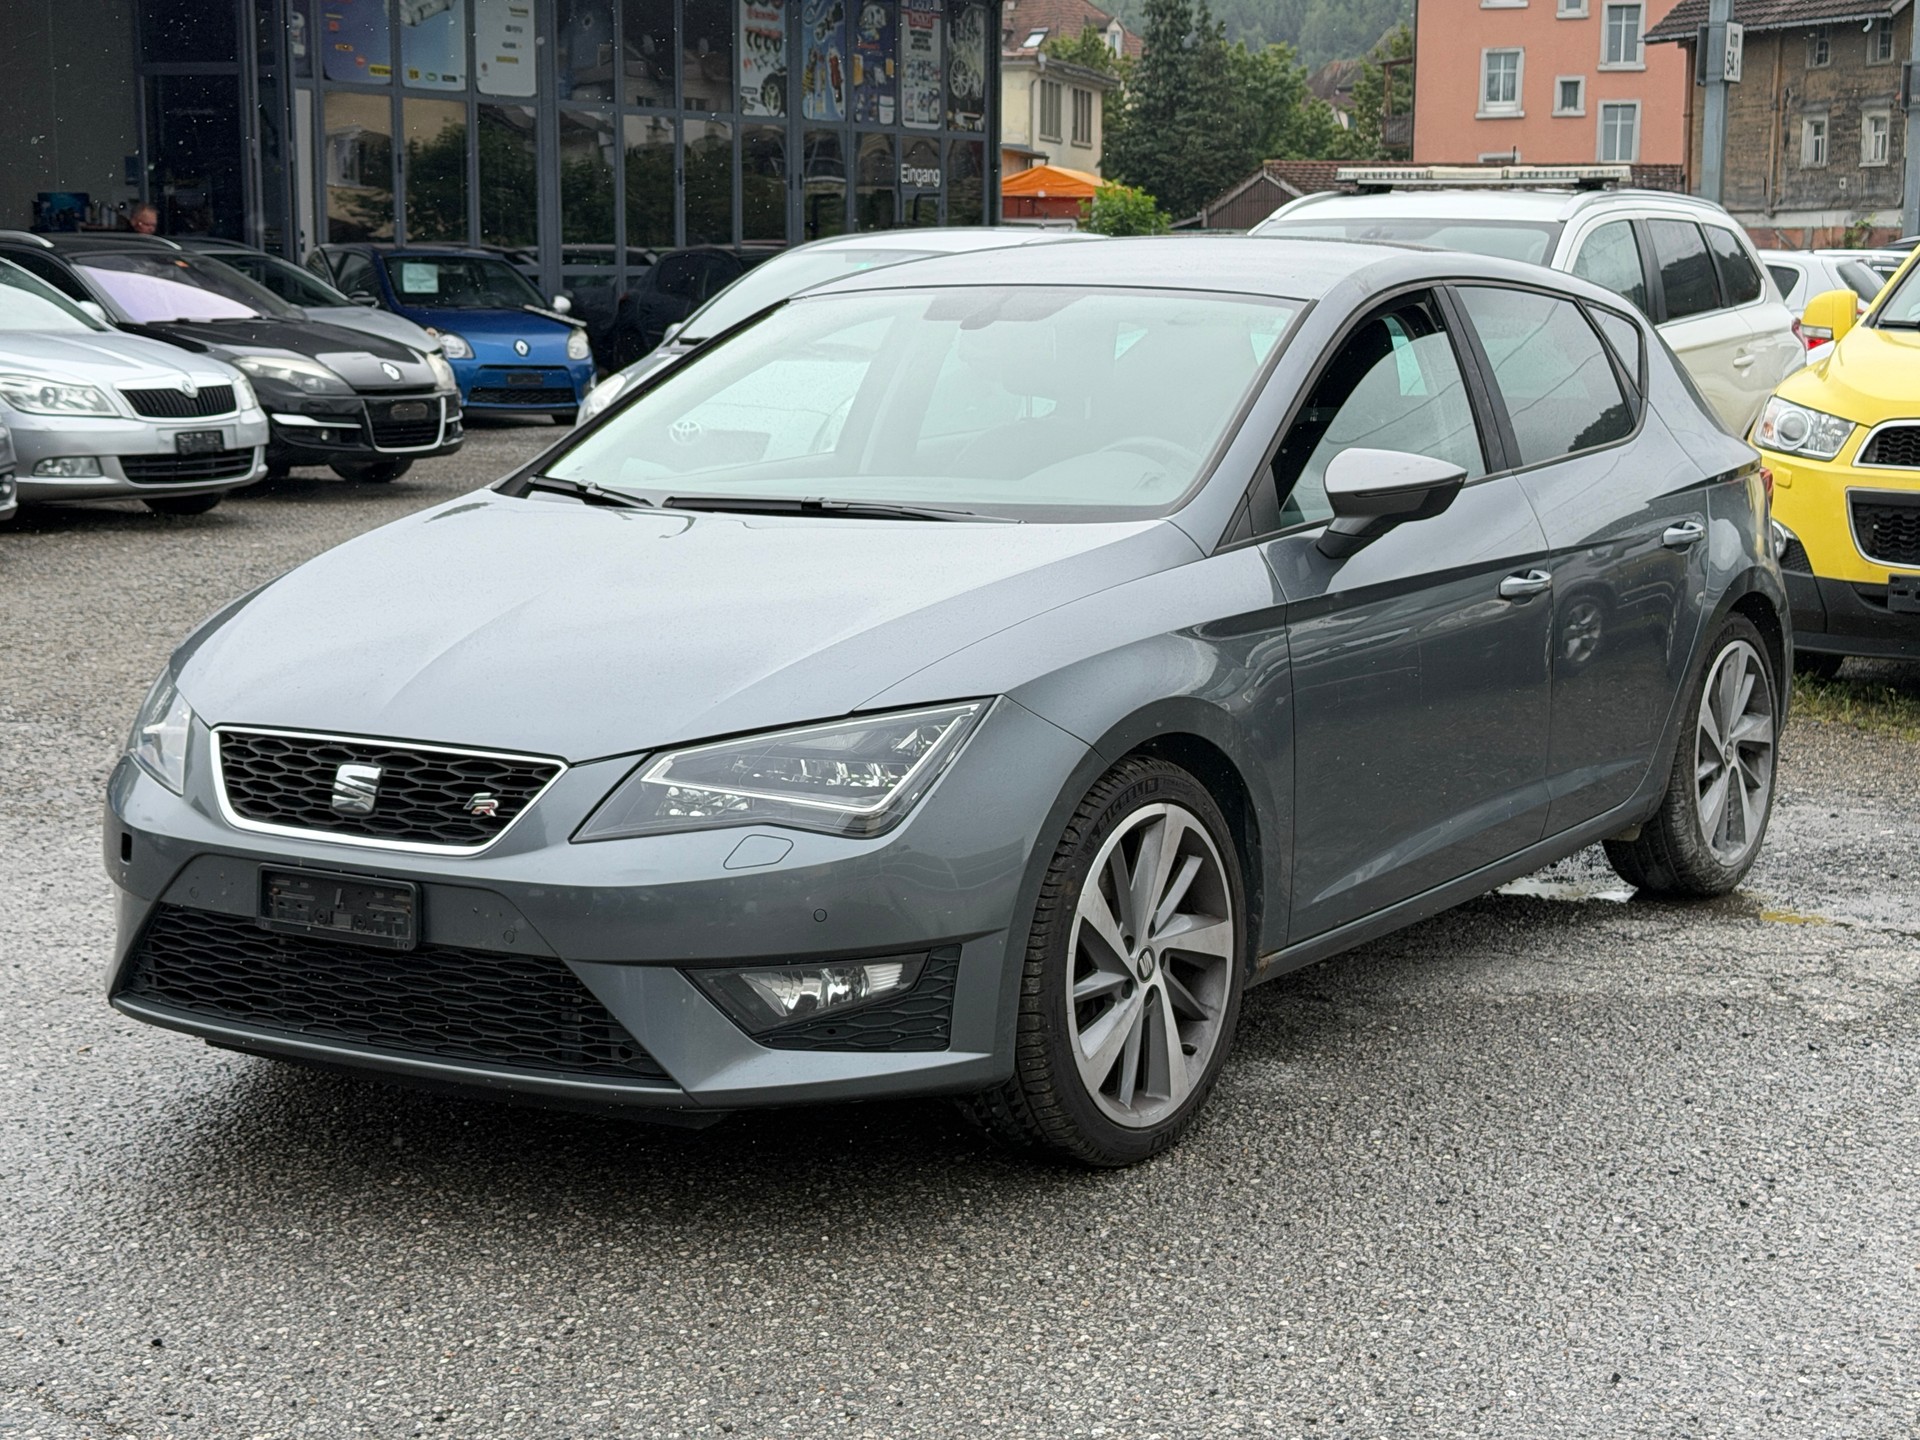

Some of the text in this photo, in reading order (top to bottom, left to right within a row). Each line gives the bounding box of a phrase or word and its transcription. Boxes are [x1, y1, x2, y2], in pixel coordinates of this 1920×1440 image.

[1730, 27, 1739, 48] km
[901, 163, 941, 188] Eingang
[463, 792, 499, 817] FR
